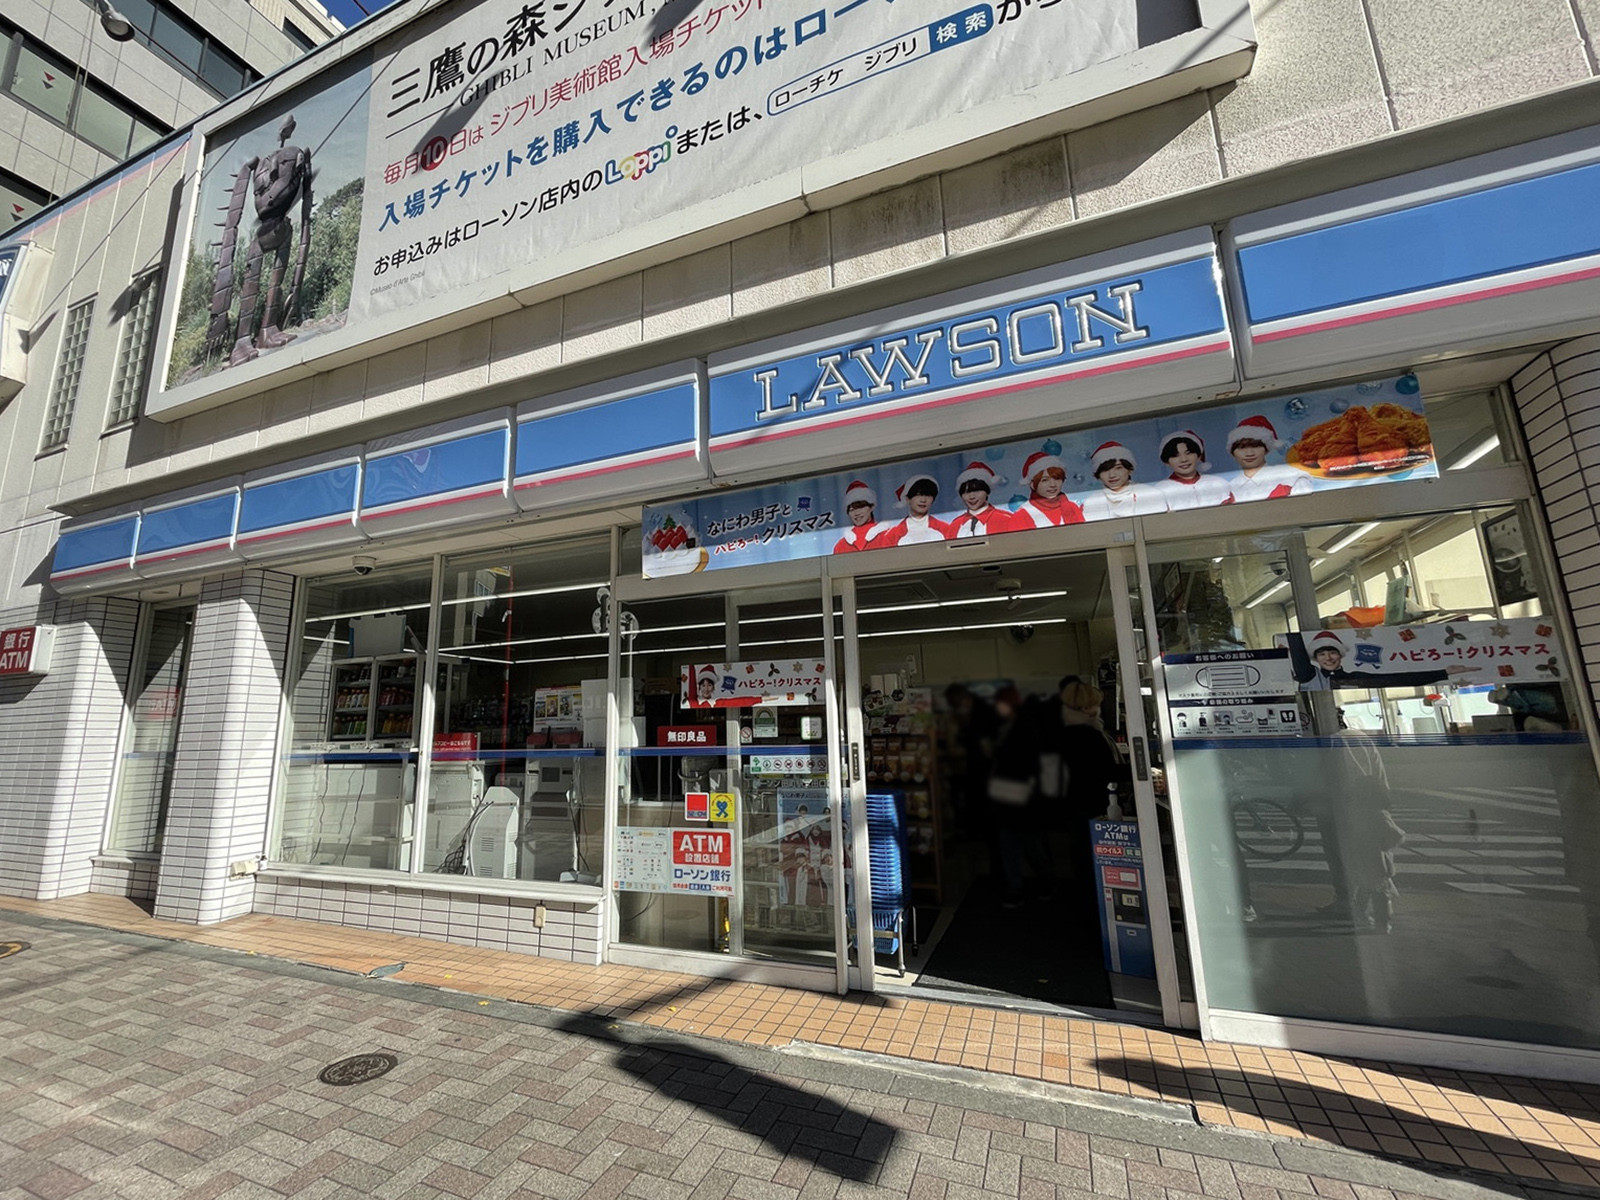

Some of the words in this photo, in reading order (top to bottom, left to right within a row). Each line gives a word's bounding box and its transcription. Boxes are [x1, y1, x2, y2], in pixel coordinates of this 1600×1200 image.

[387, 0, 614, 117] 三鷹の森ジ
[775, 68, 844, 107] ローチケ
[865, 37, 917, 71] ジブリ
[936, 11, 987, 44] 検索
[460, 56, 533, 107] GHIBLI
[378, 0, 894, 231] 入場チケットを購入できるのはロー
[754, 281, 1150, 421] LAWSON
[706, 503, 792, 536] なにわ男子と
[0, 651, 29, 670] ATM
[667, 731, 707, 743] 無印良品
[679, 834, 724, 853] ATM
[673, 868, 732, 882] ローソン銀行
